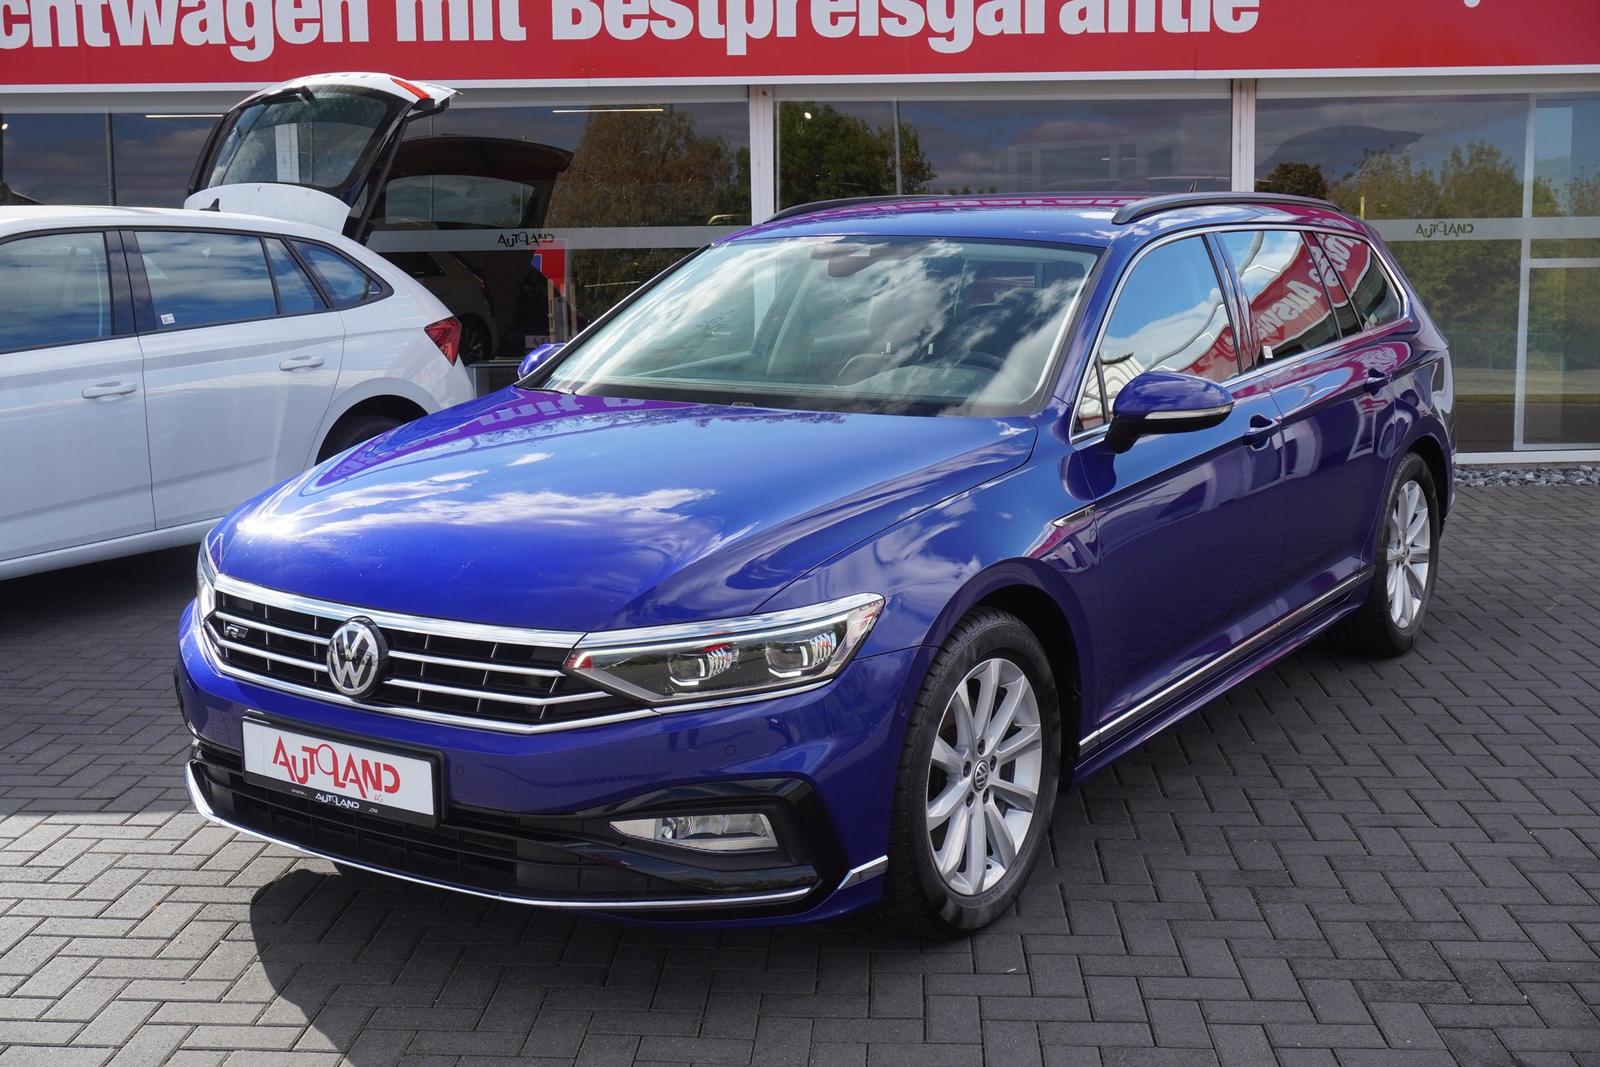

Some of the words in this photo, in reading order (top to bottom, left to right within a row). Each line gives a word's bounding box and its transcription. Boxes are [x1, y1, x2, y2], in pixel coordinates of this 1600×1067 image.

[395, 0, 527, 41] mit
[272, 736, 401, 799] AUTOLAND
[315, 792, 360, 809] AUTOLAND
